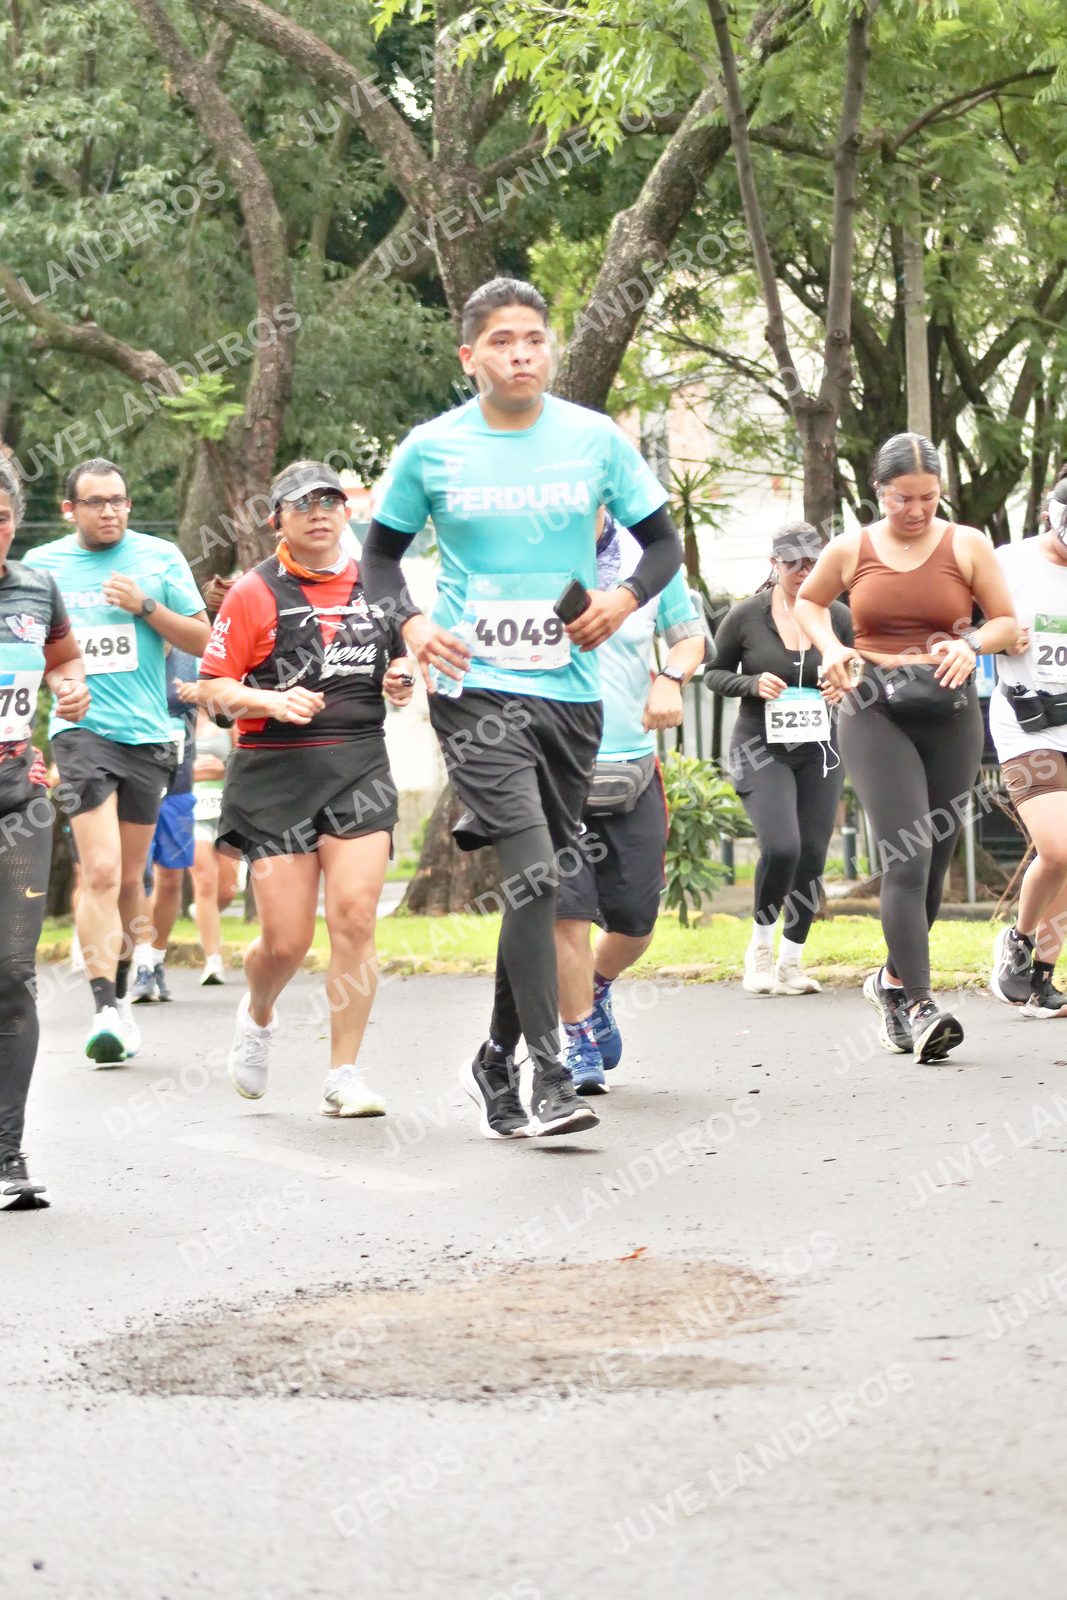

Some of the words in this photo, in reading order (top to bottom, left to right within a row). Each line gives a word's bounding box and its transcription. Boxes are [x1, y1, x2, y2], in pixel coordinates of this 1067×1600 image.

[446, 480, 591, 512] PERDURA
[475, 618, 563, 647] 4049
[78, 636, 131, 657] 498
[771, 710, 822, 729] 5233
